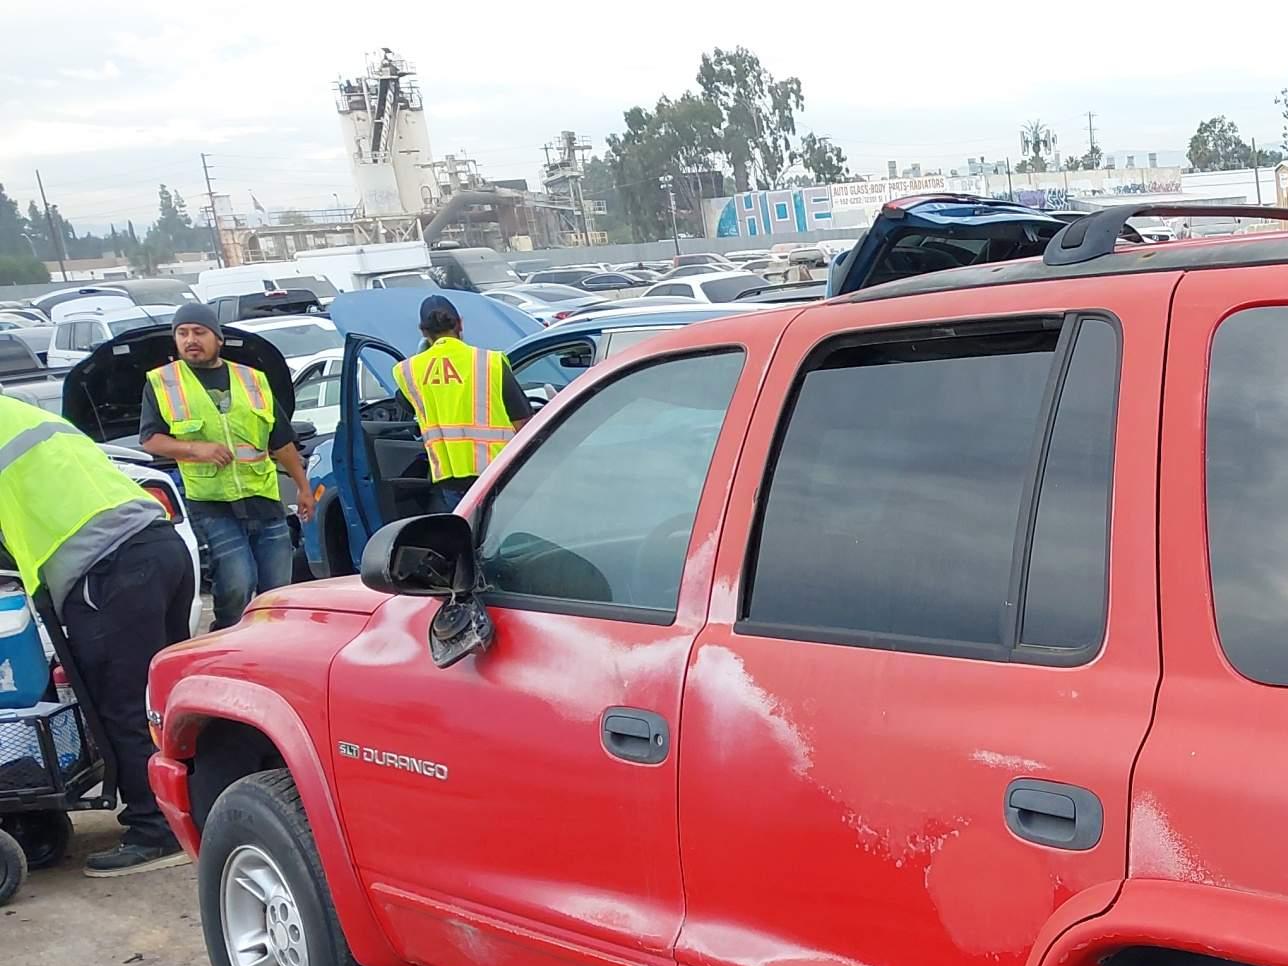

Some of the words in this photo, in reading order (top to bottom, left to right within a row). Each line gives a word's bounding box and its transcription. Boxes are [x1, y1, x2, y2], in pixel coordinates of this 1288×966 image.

[833, 186, 849, 197] AUTO
[339, 742, 360, 758] SLT
[362, 746, 449, 780] DURANGO
